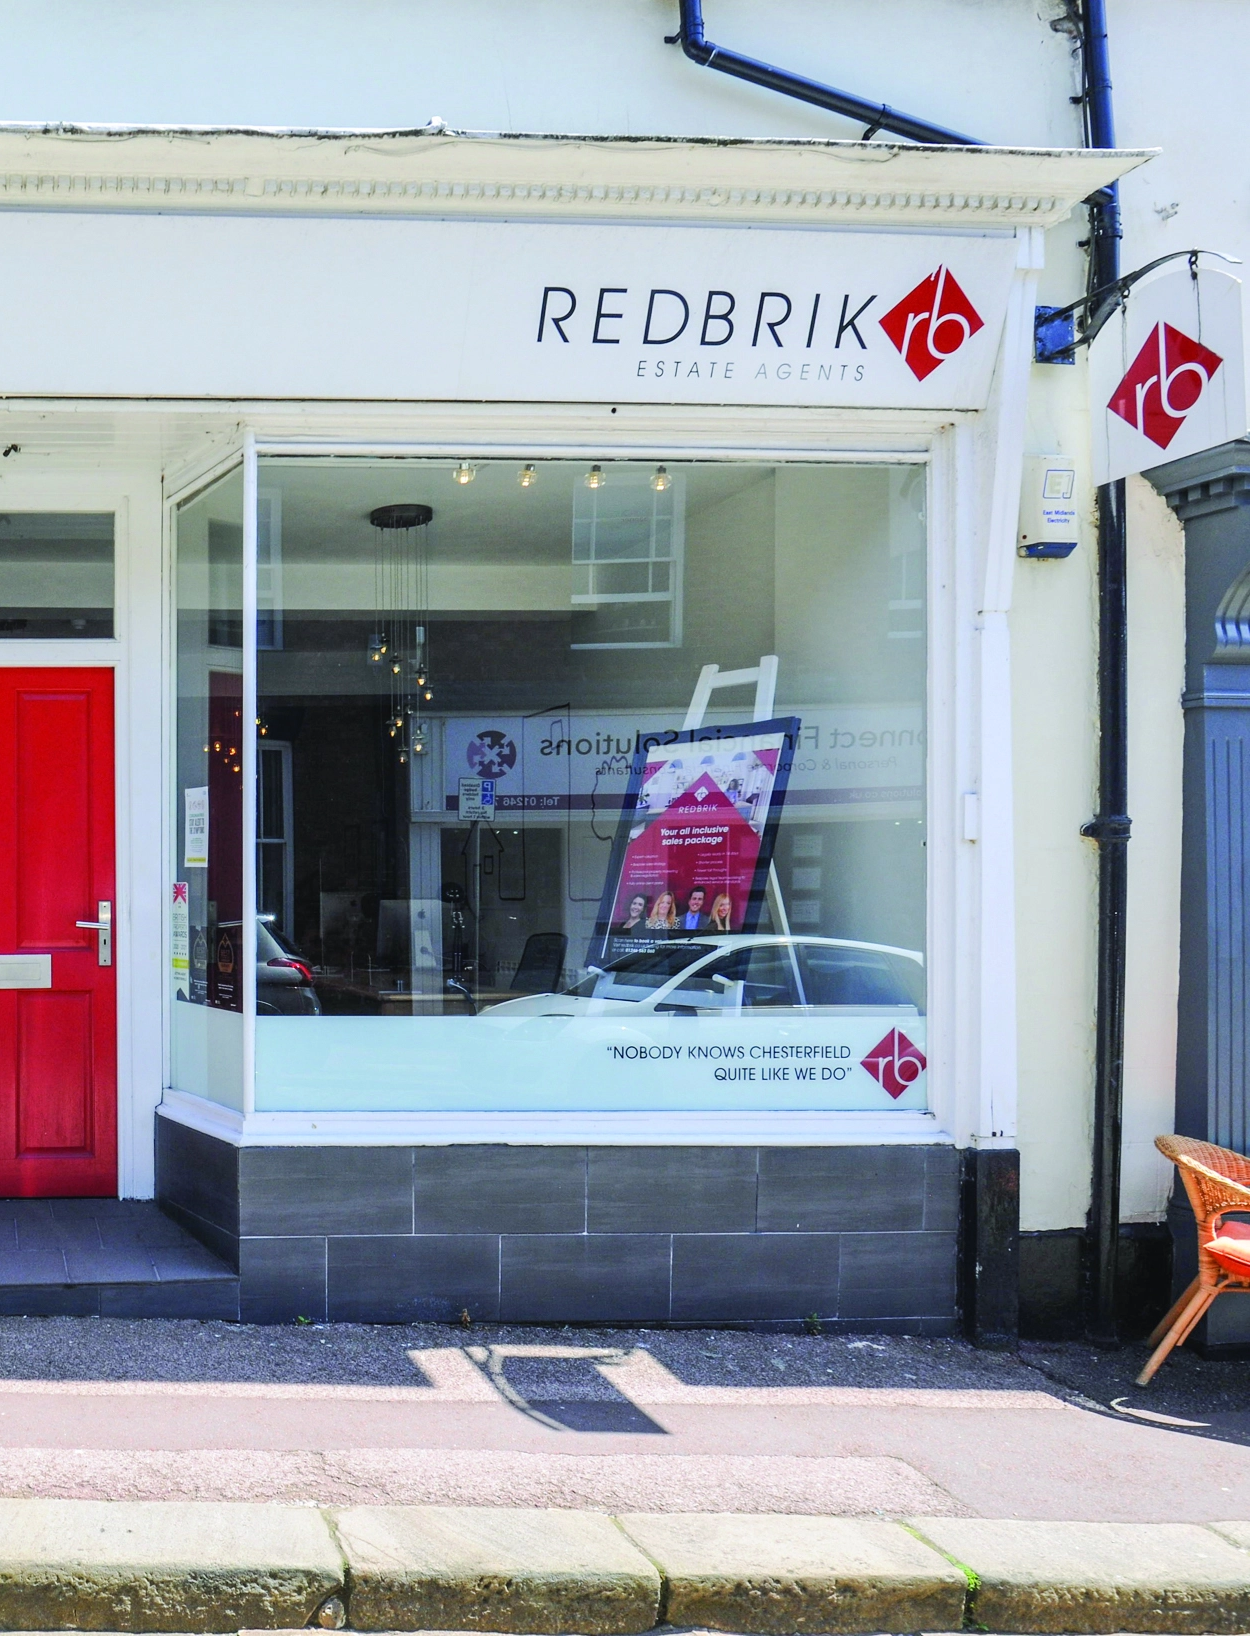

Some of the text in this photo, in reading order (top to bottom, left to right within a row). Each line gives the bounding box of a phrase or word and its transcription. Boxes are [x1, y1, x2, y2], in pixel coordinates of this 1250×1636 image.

[536, 286, 878, 349] REDBRIK
[636, 359, 866, 382] ESTATE AGENTS
[678, 804, 719, 814] REDBRIK
[660, 825, 729, 837] Your all inclusive
[661, 835, 723, 846] sales package
[687, 1046, 745, 1060] KNOWS
[749, 1045, 851, 1059] CHESTERFIELD
[714, 1067, 756, 1082] QUITE
[761, 1067, 791, 1081] LIKE
[794, 1067, 817, 1081] WE
